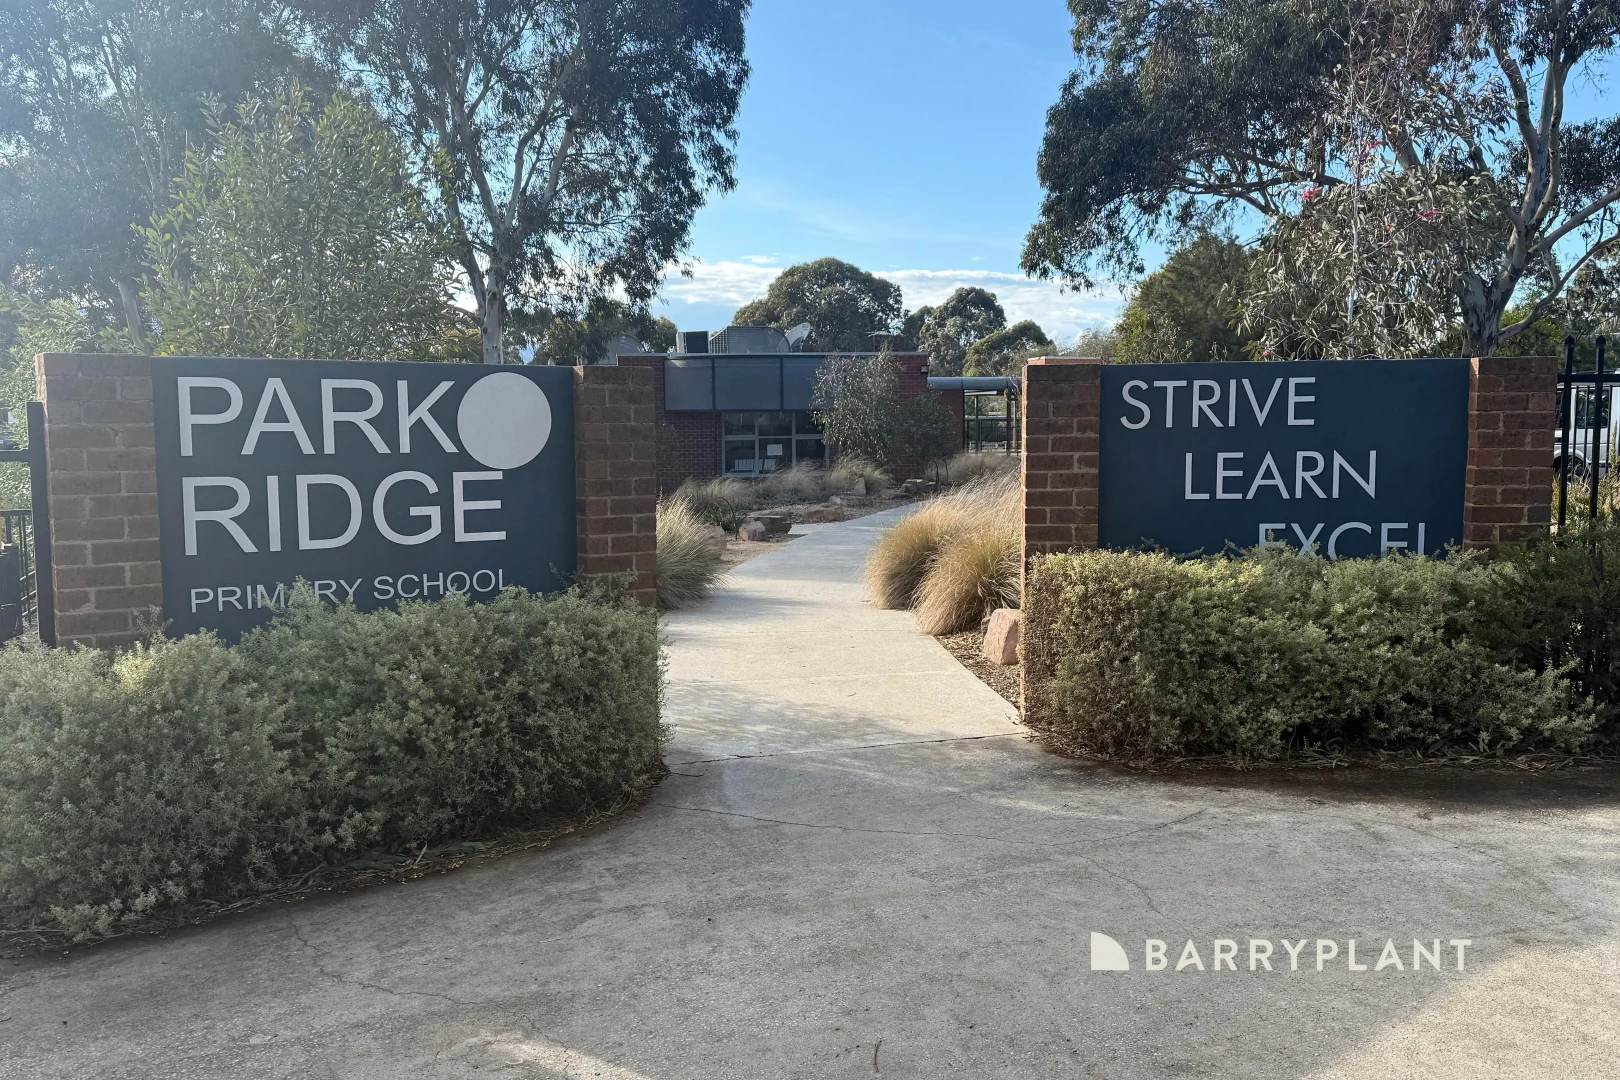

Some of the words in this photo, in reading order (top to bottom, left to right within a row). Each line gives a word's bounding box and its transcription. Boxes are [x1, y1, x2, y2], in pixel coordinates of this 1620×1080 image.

[177, 376, 459, 457] PARK
[1120, 376, 1316, 430] STRIVE
[1184, 449, 1377, 500] LEARN
[182, 470, 507, 556] RIDGE
[190, 578, 363, 613] PRIMRY
[373, 568, 509, 601] SCHOOL
